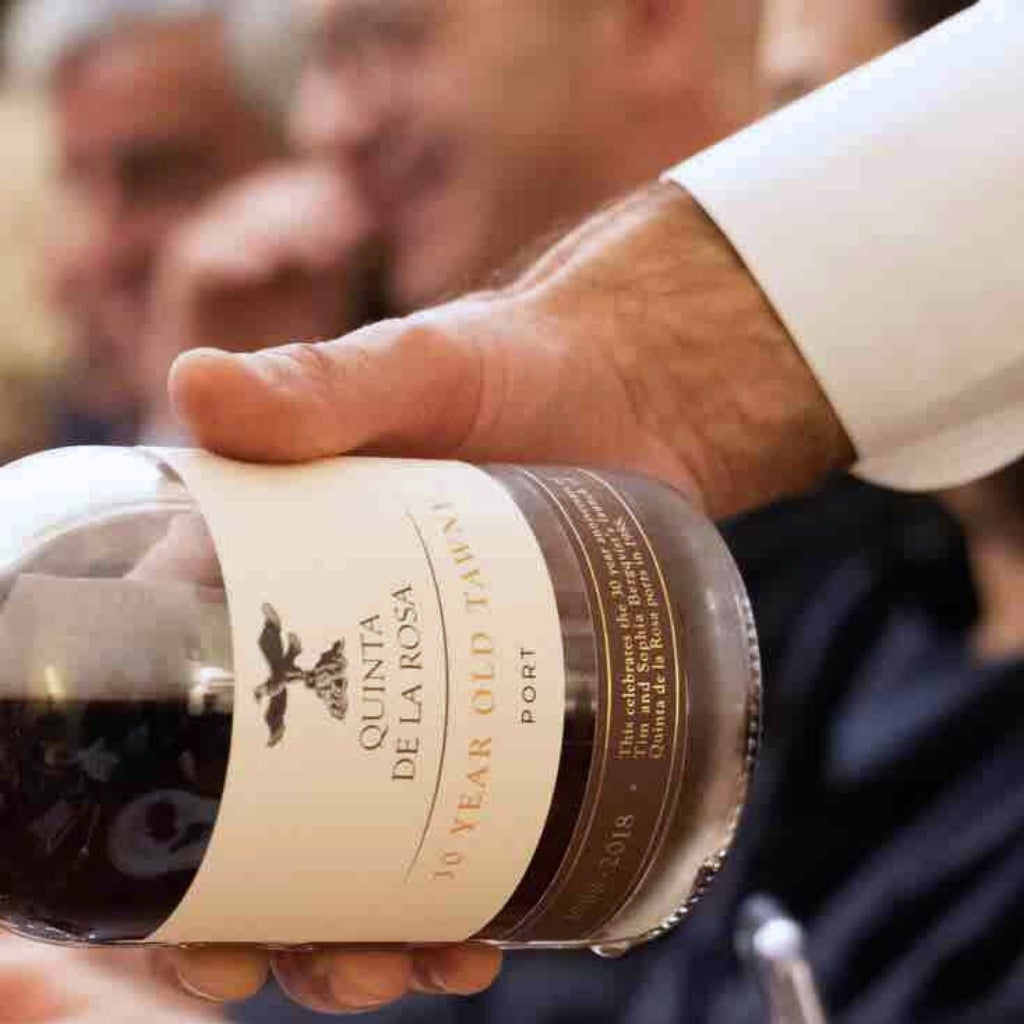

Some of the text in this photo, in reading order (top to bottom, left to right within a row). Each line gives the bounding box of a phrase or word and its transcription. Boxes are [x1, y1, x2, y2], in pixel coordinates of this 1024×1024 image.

[615, 603, 629, 629] the
[634, 613, 651, 673] Sophia
[649, 612, 664, 649] Rosa
[358, 614, 388, 751] QUINTA
[391, 583, 422, 781] DE LA ROSA
[469, 632, 495, 715] OLD
[519, 647, 537, 725] PORT
[621, 635, 635, 715] celebrates
[652, 655, 665, 669] la
[652, 673, 666, 695] de
[636, 681, 651, 713] and
[614, 722, 635, 758] This
[633, 723, 649, 758] Tim
[649, 700, 666, 758] Quinta
[449, 737, 493, 834] YEAR
